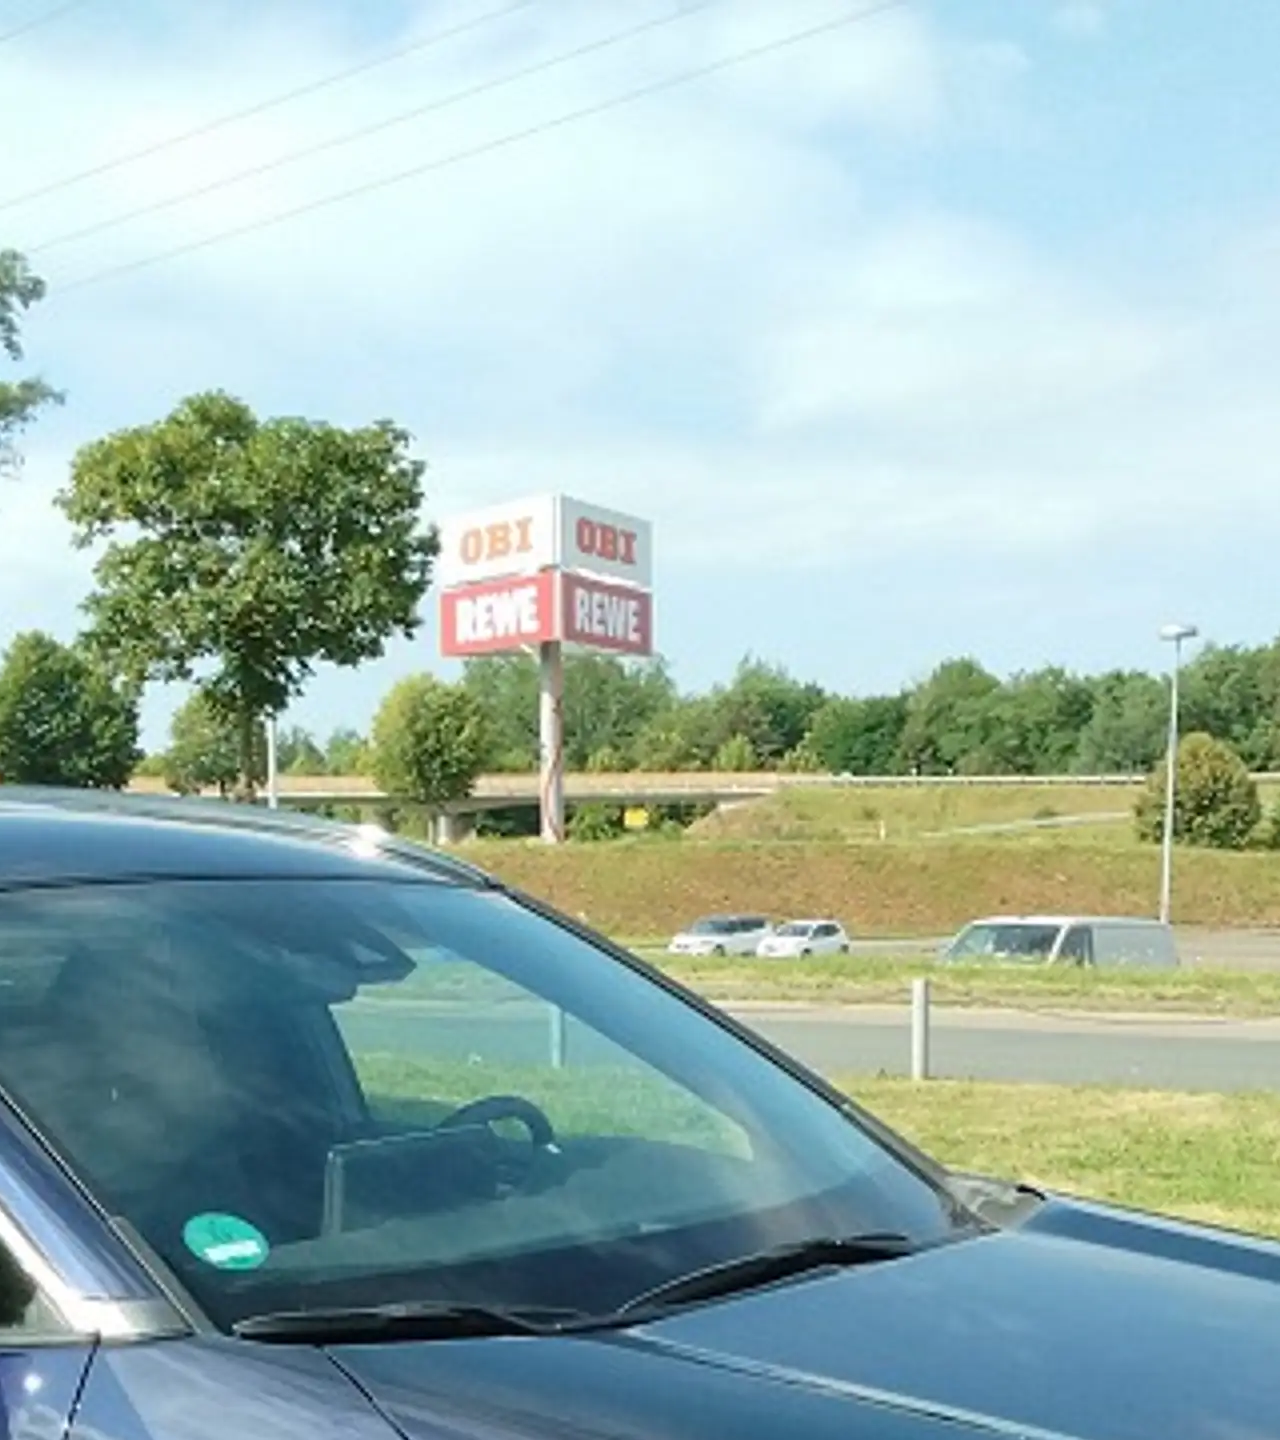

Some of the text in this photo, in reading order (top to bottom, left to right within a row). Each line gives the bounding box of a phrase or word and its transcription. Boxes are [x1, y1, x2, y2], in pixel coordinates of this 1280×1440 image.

[459, 516, 534, 564] OBI
[576, 516, 637, 565] OBI
[456, 585, 540, 644] REWE
[575, 587, 641, 642] REWE
